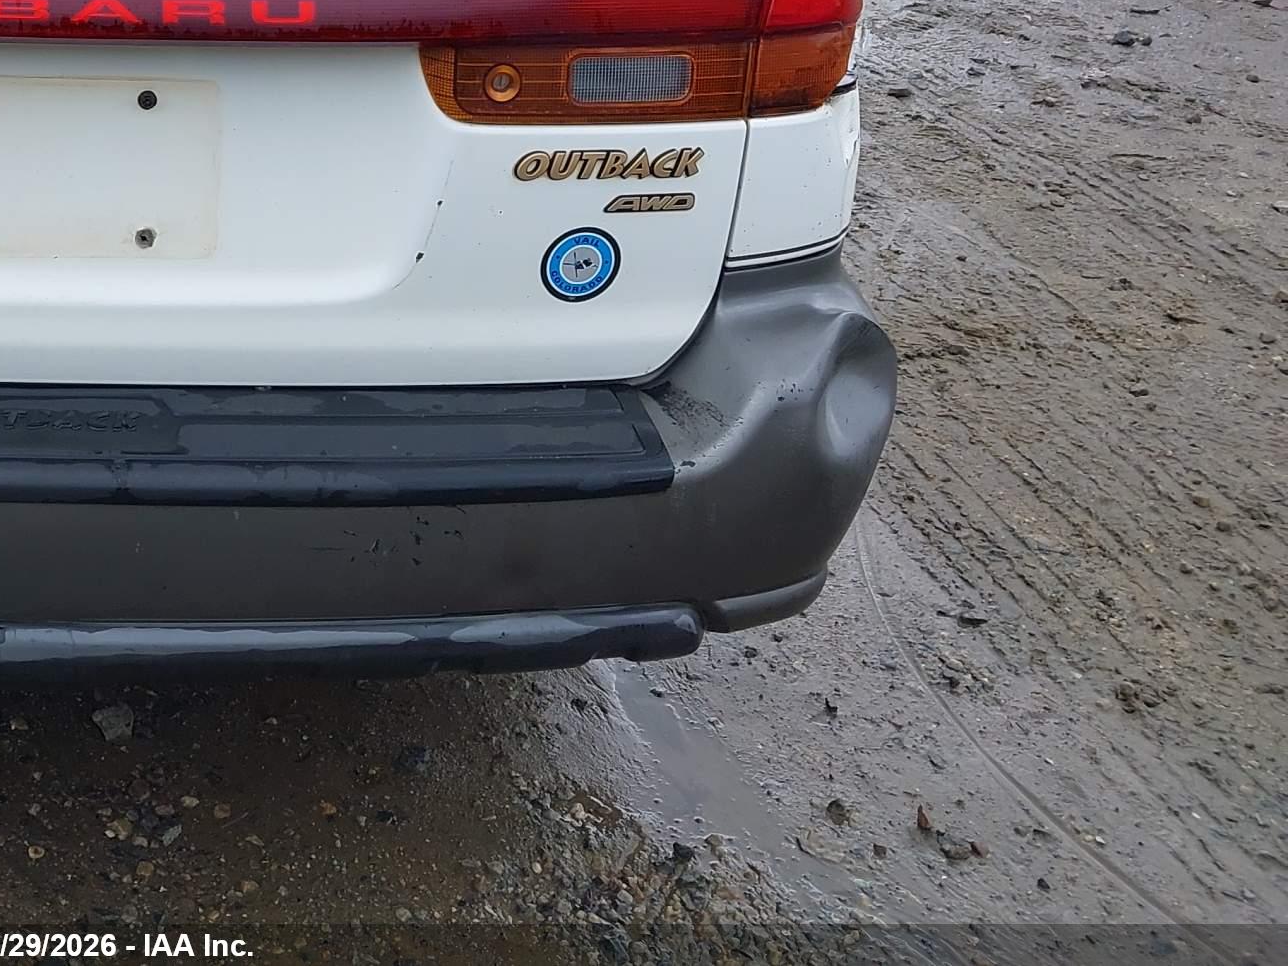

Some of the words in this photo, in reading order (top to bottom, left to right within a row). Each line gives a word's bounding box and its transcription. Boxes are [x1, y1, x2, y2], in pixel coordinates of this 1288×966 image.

[514, 146, 705, 181] OUTBACK
[604, 193, 696, 213] AWD
[573, 237, 600, 248] VAIL
[551, 270, 604, 293] COLORADO
